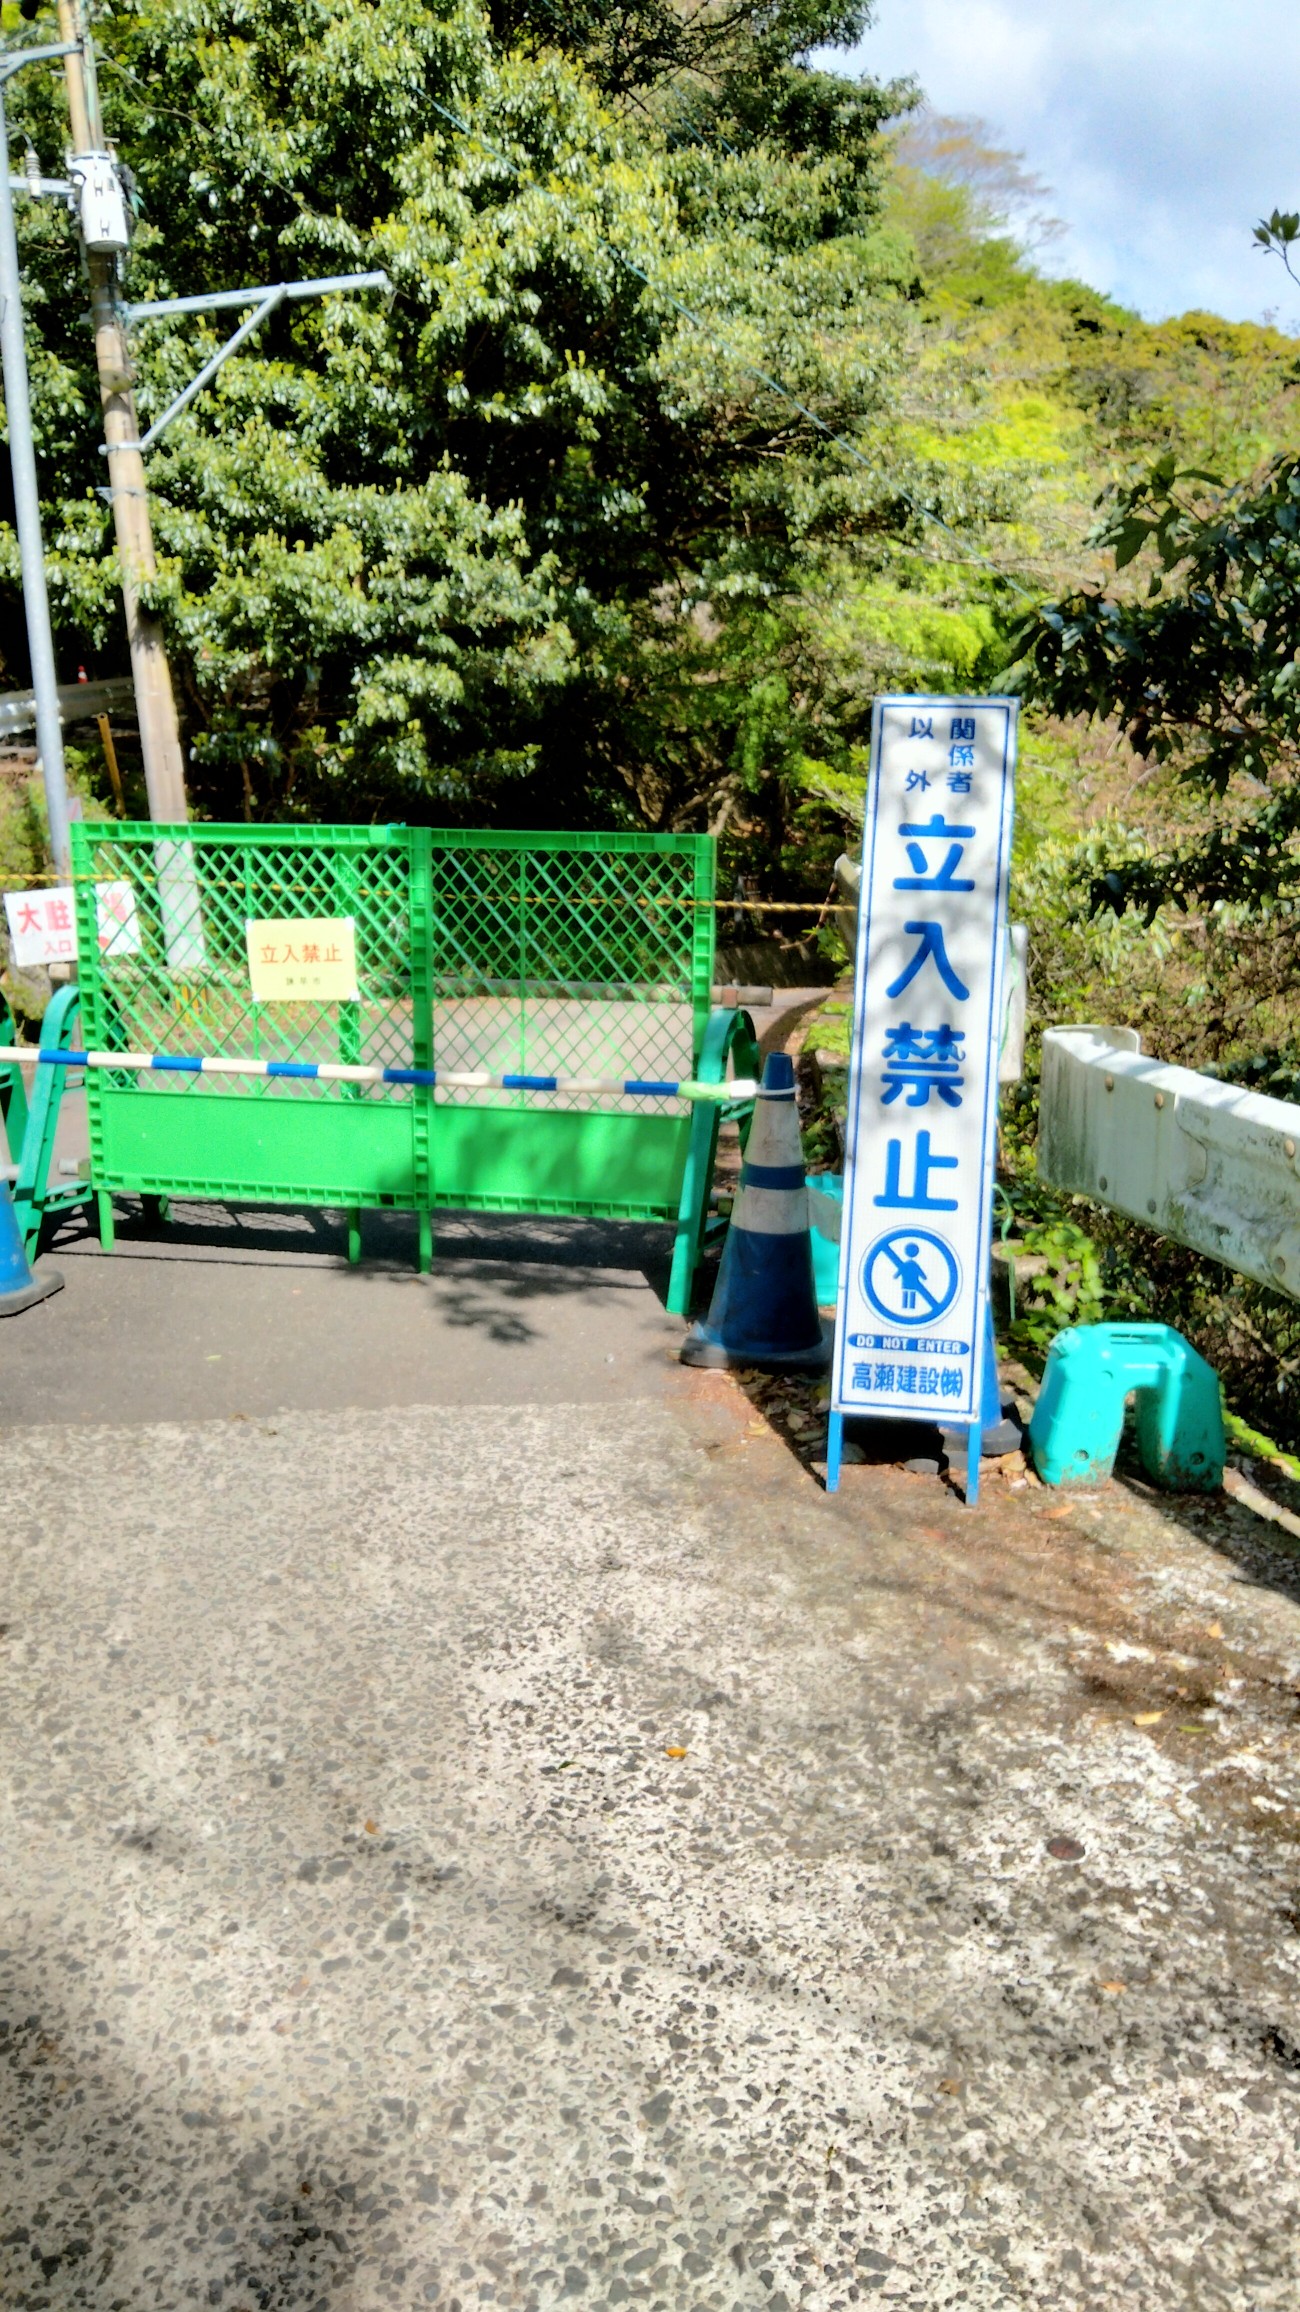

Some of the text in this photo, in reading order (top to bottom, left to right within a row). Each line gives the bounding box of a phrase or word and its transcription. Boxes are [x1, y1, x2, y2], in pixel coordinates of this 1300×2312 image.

[905, 717, 934, 792] 以外
[946, 717, 975, 793] 関係者
[260, 943, 343, 964] 立入禁止
[873, 814, 976, 1211] 立入禁止
[856, 1334, 961, 1354] DO NOT ENTER
